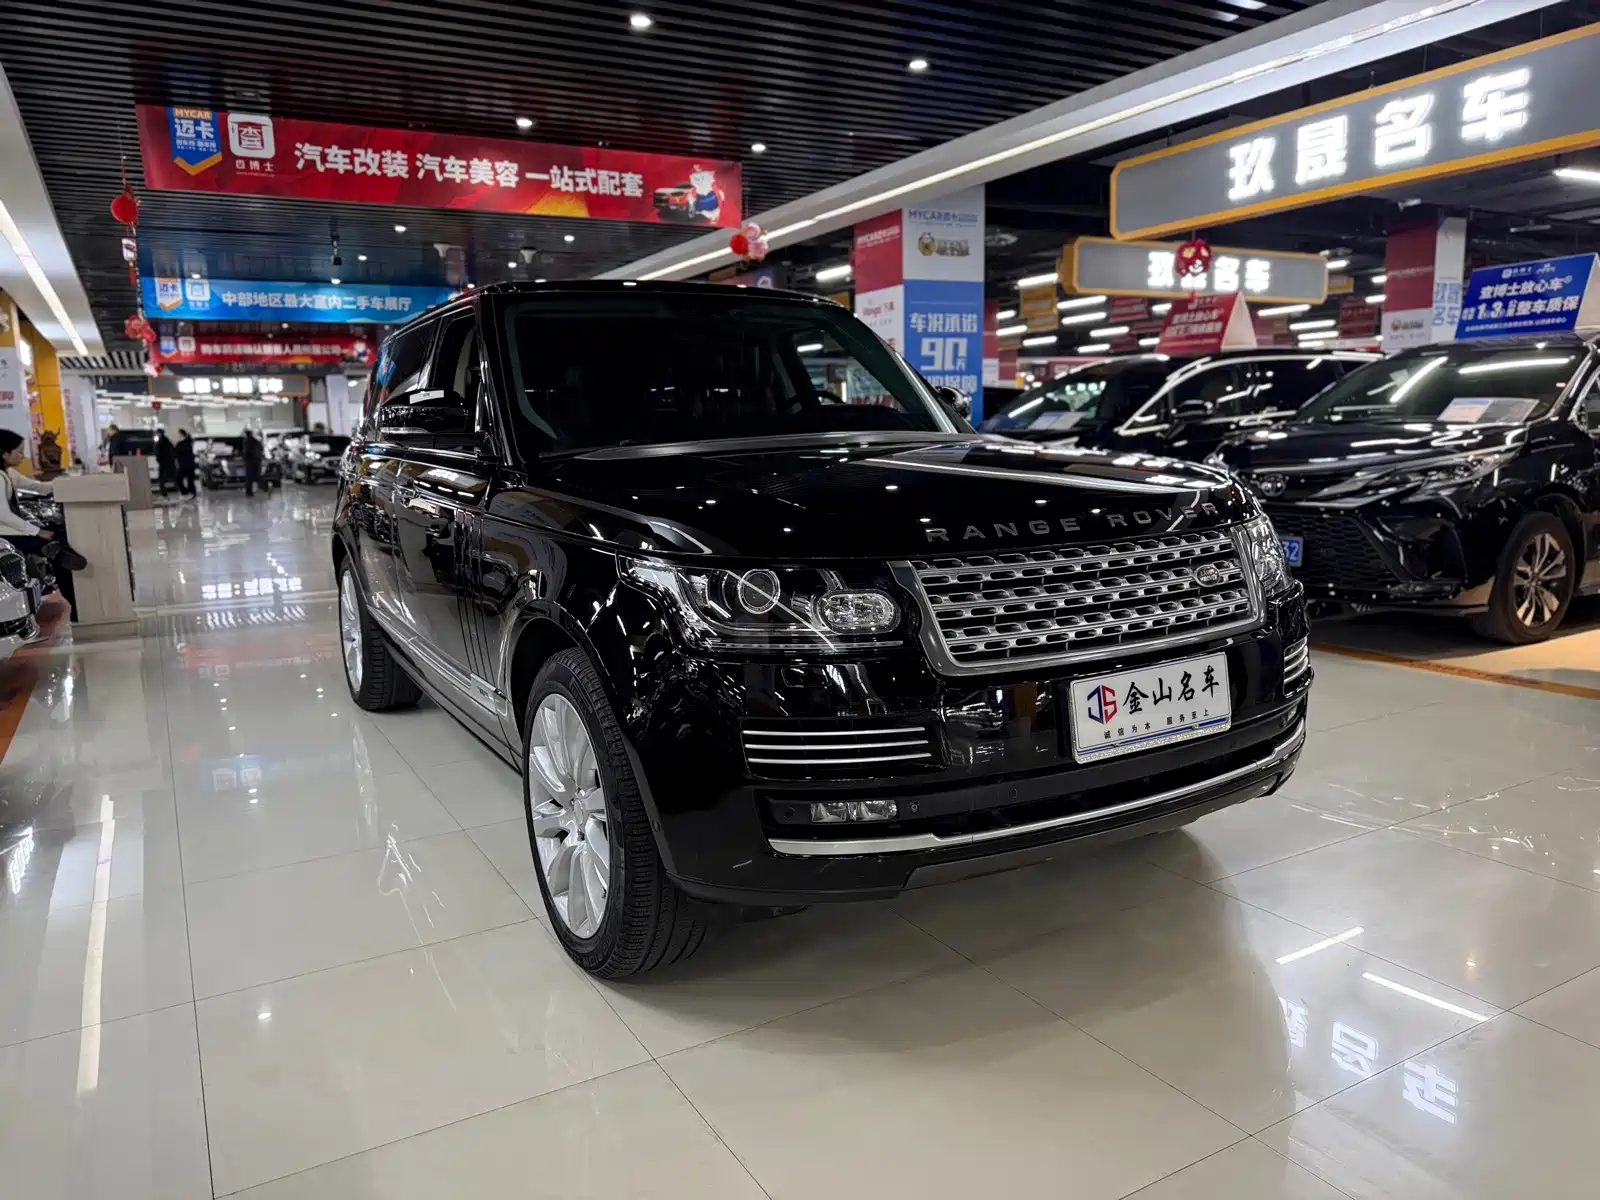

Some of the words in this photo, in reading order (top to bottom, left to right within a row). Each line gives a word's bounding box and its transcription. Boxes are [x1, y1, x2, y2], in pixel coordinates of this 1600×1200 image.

[174, 108, 212, 120] MYCAR
[174, 118, 215, 140] 迈卡
[1227, 67, 1531, 202] 玖晟名车
[294, 142, 409, 179] 汽车改装
[416, 152, 519, 188] 汽车美容
[525, 164, 643, 198] 一站式配套
[925, 516, 1081, 542] RANGE
[1106, 502, 1219, 528] ROVER
[1122, 664, 1220, 715] 金山名车
[1103, 721, 1151, 739] 诚信为本
[1166, 708, 1210, 726] 服务至上
